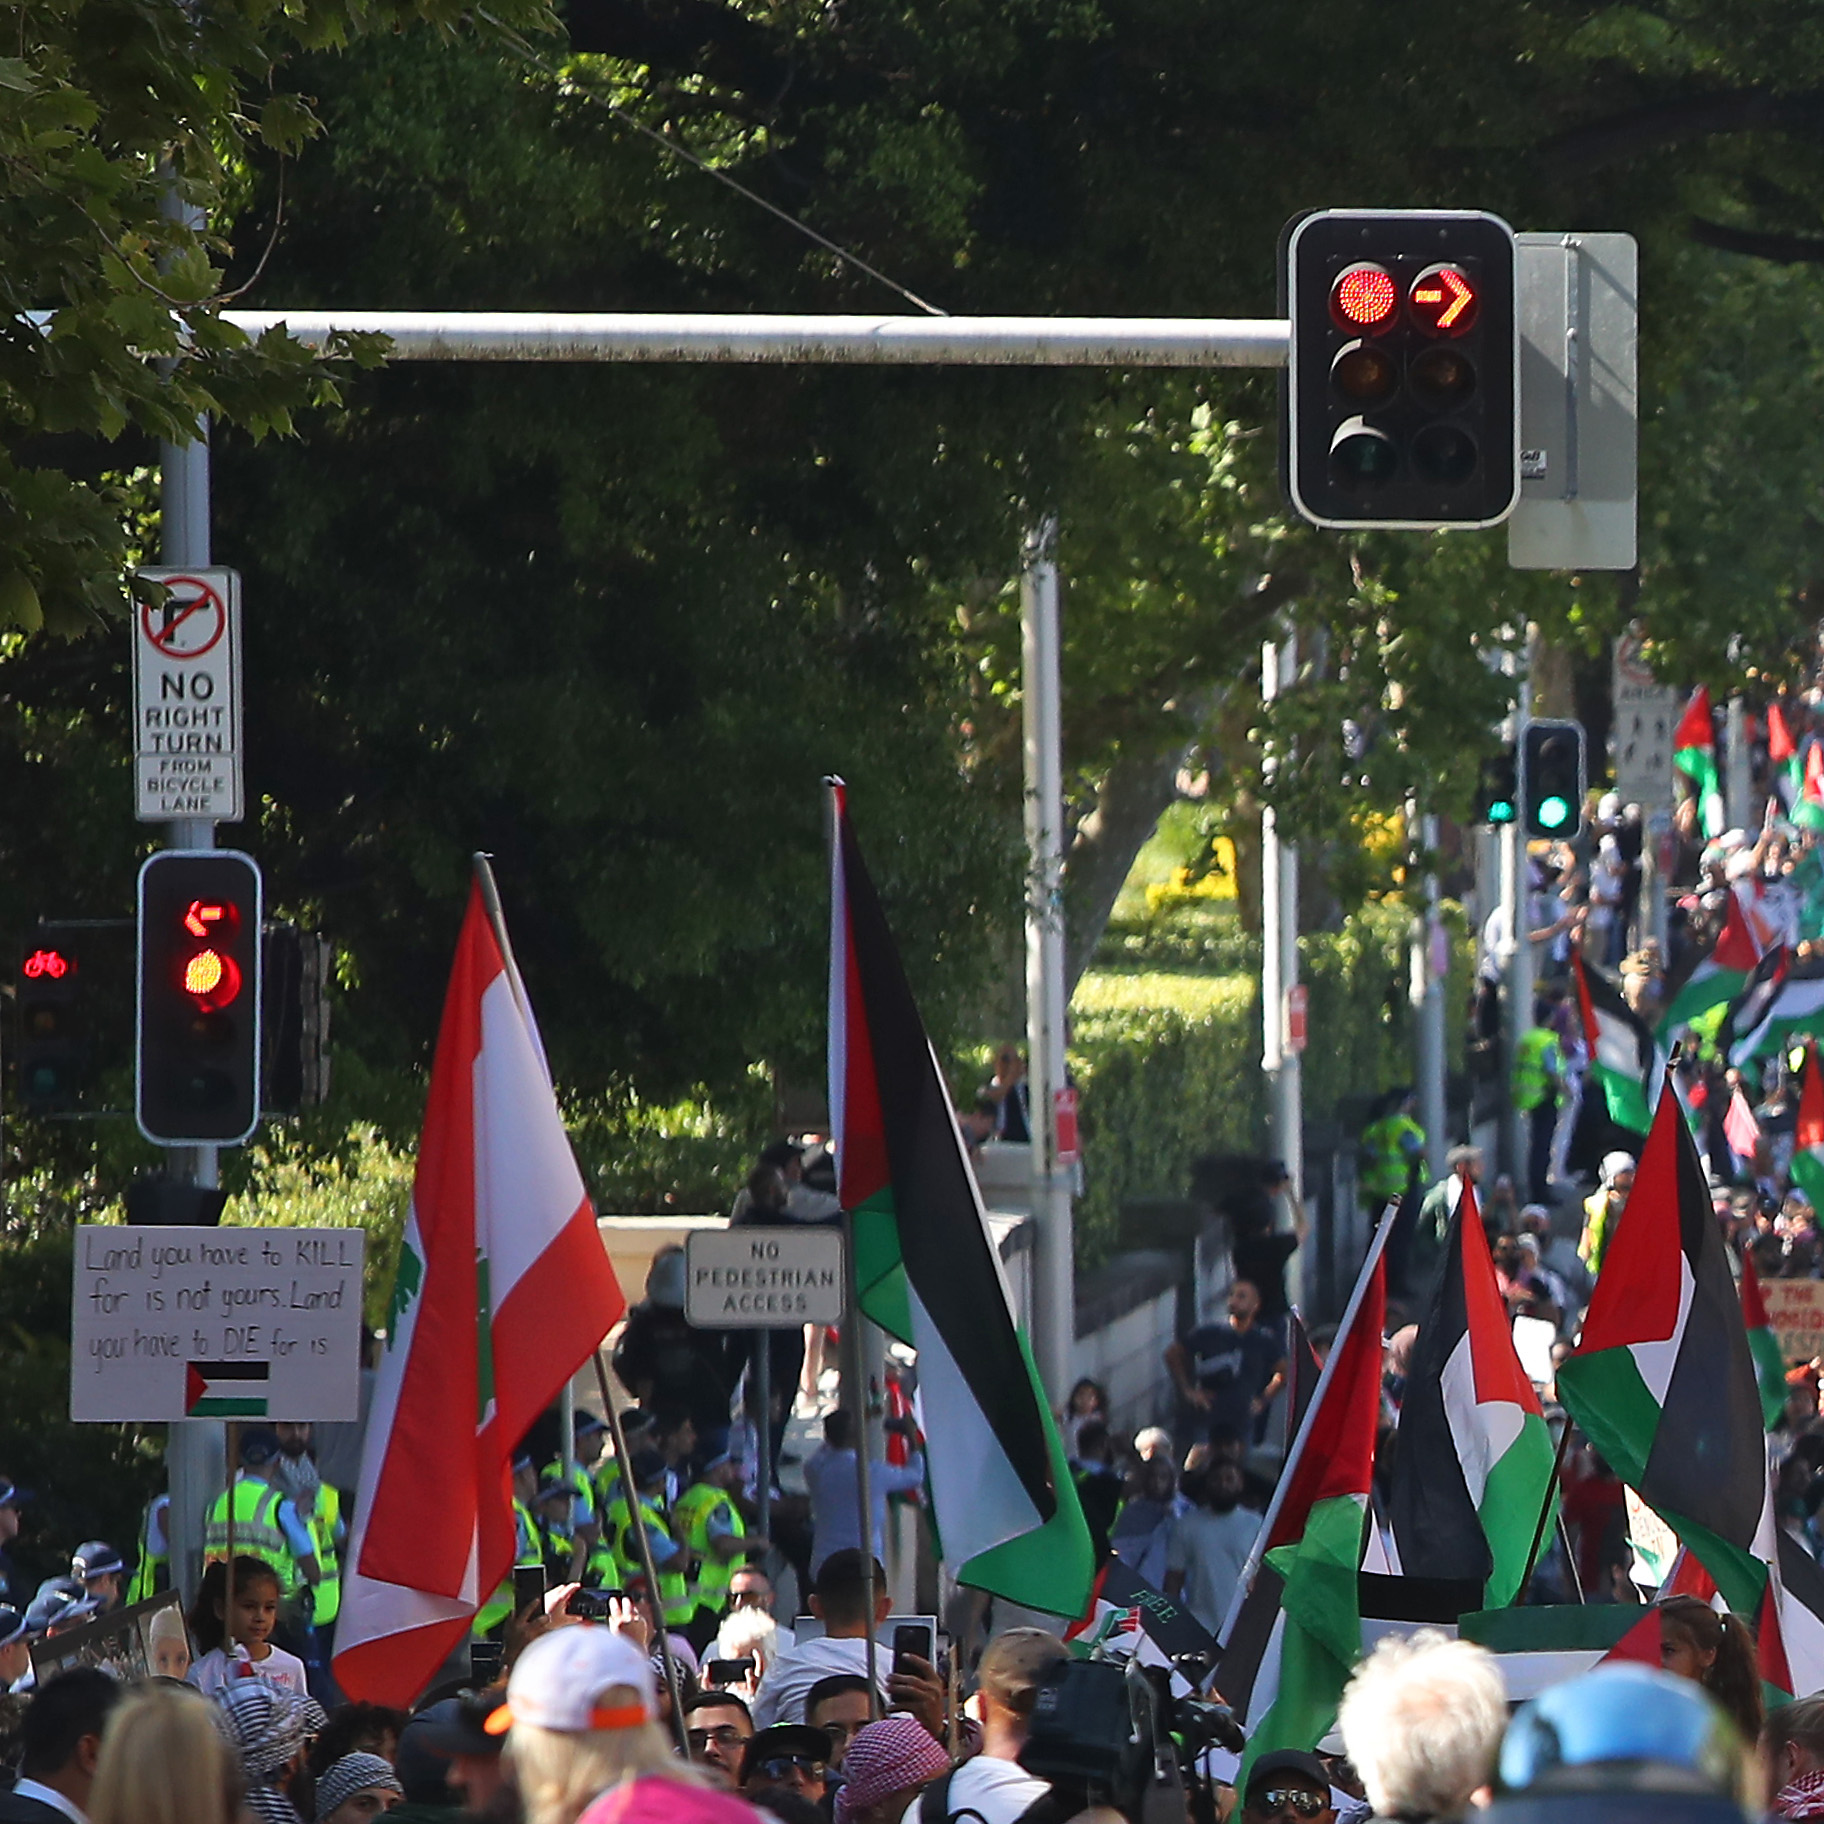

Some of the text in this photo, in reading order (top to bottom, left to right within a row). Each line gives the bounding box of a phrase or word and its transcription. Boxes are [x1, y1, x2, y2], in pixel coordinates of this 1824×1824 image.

[162, 671, 214, 701] NO
[145, 706, 224, 728] RIGHT
[150, 732, 223, 754] TURN
[160, 759, 212, 774] FROM
[147, 777, 224, 793] BICYCLE
[160, 796, 210, 811] LANE
[85, 1234, 353, 1280] Land you have to KILL
[751, 1240, 779, 1260] NO
[696, 1267, 834, 1288] PEDESTRIAN
[89, 1277, 129, 1314] for
[146, 1288, 164, 1311] is
[177, 1280, 212, 1311] not
[723, 1292, 807, 1313] ACCESS
[89, 1325, 328, 1374] you have to DIE for is
[1130, 1590, 1178, 1624] FREE
